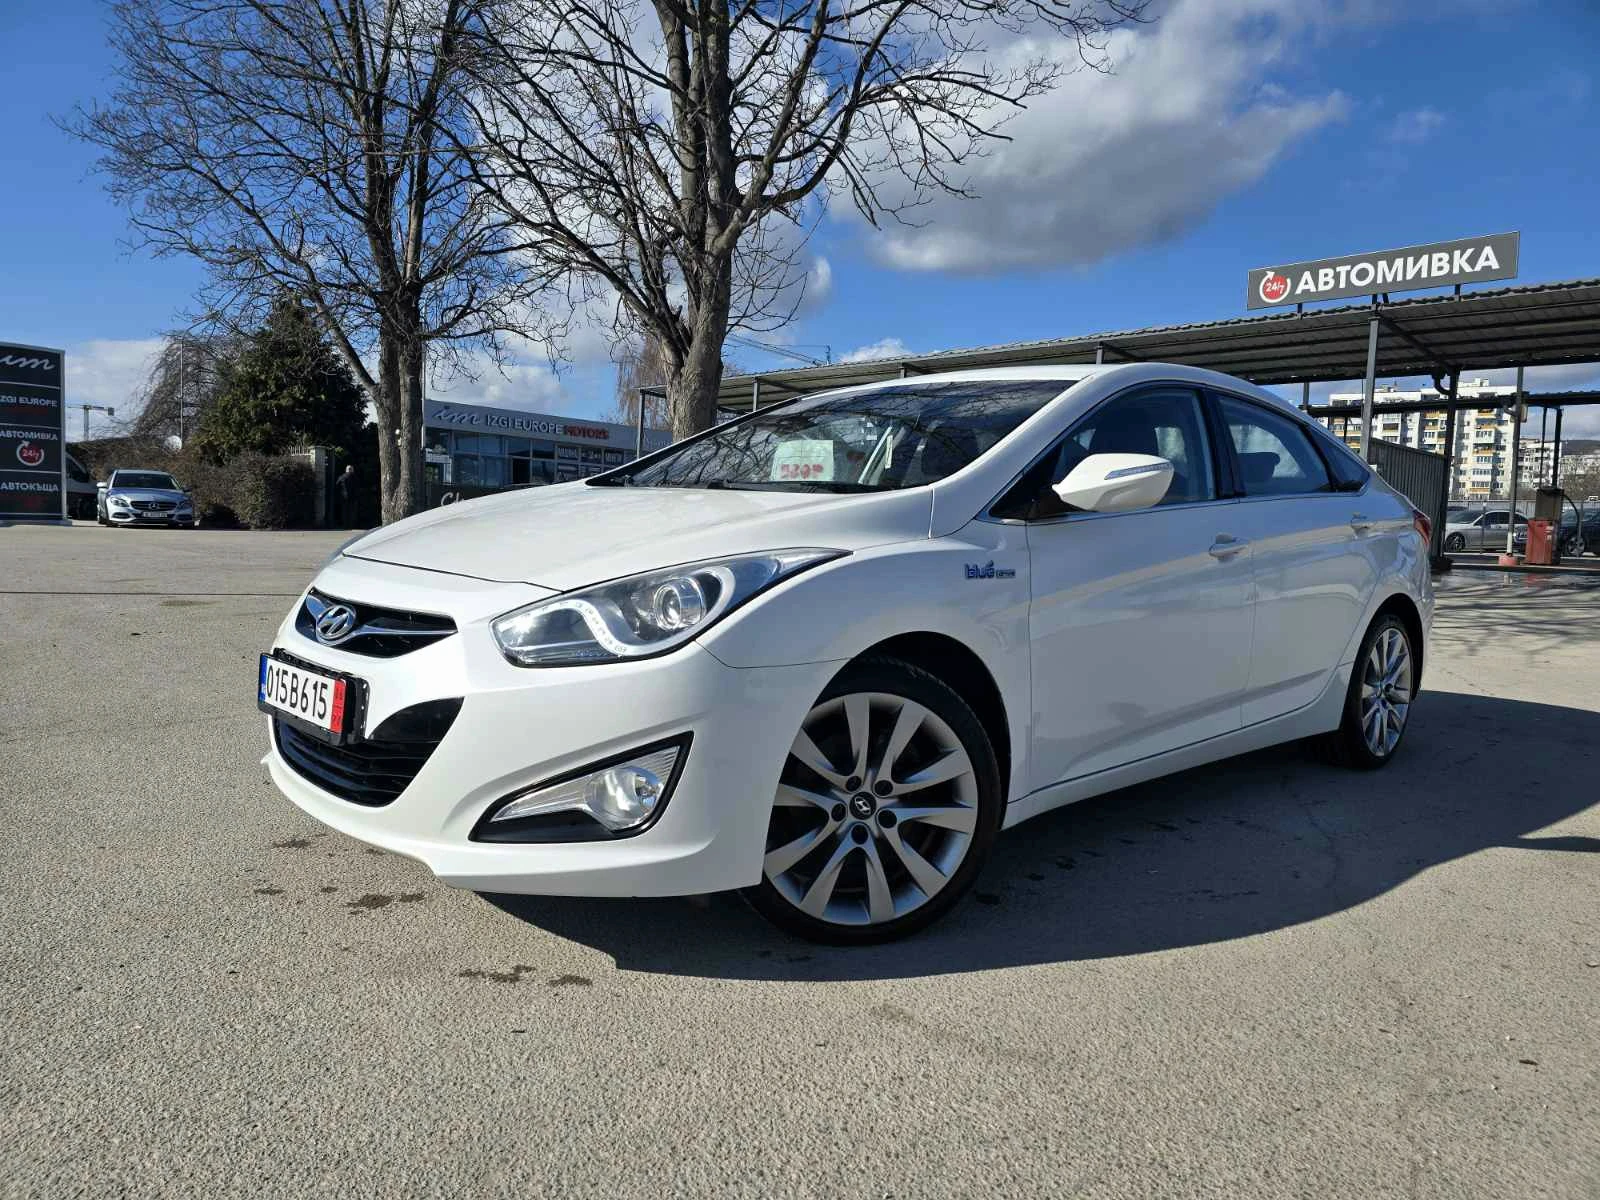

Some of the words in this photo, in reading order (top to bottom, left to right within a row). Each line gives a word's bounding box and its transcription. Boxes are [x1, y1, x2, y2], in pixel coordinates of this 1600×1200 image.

[1295, 246, 1500, 294] АВТОМИВКА
[0, 430, 58, 440] АВТОМИВКА
[487, 414, 512, 429] IZGI
[514, 416, 563, 434] EUROPE
[266, 664, 329, 720] 015B615
